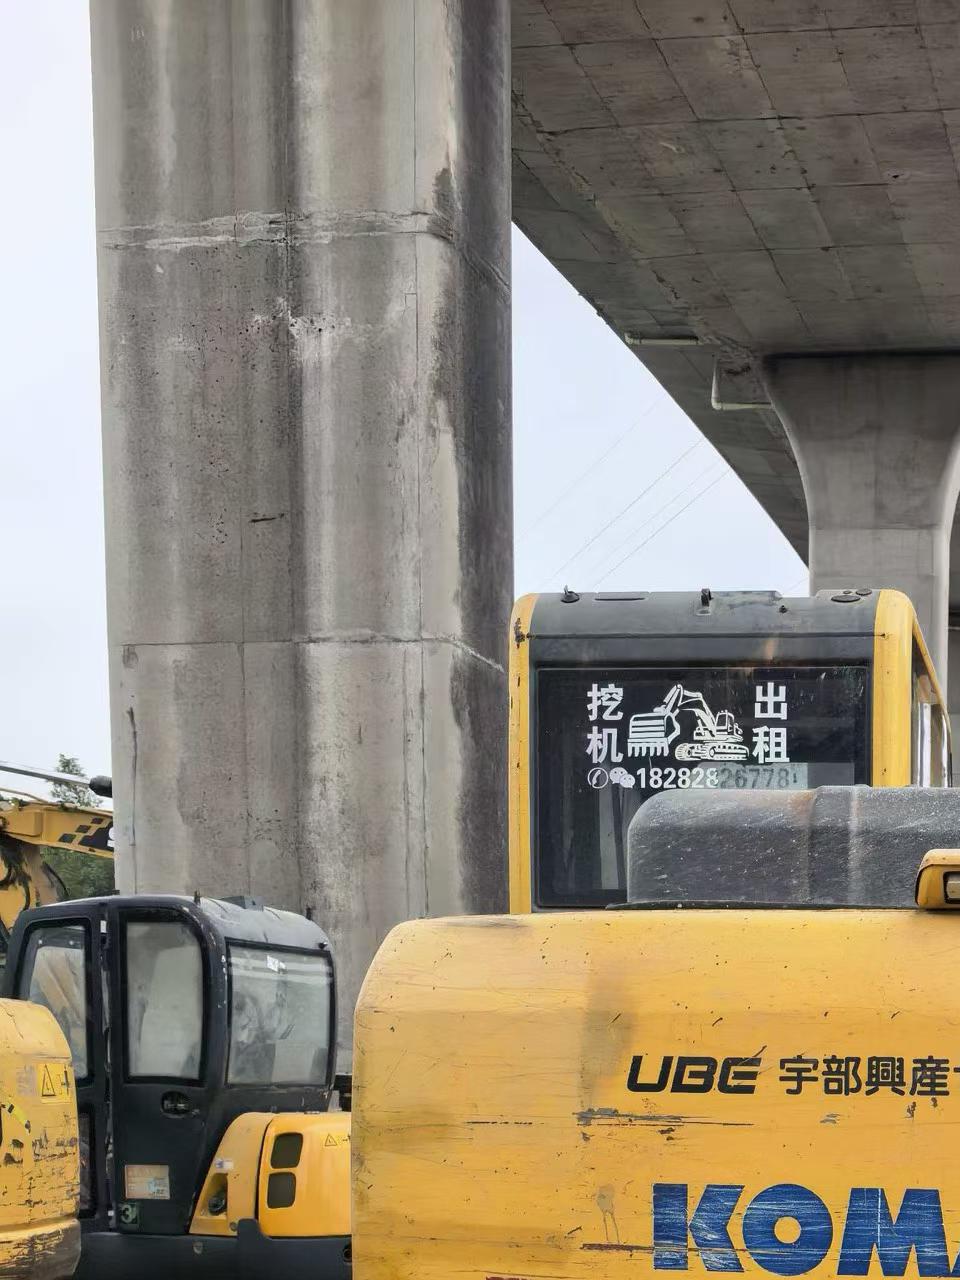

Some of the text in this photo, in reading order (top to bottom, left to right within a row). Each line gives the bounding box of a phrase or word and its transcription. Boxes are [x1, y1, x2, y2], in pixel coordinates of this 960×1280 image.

[587, 683, 624, 763] 挖机
[752, 682, 790, 763] 出租
[626, 1055, 763, 1094] UBE
